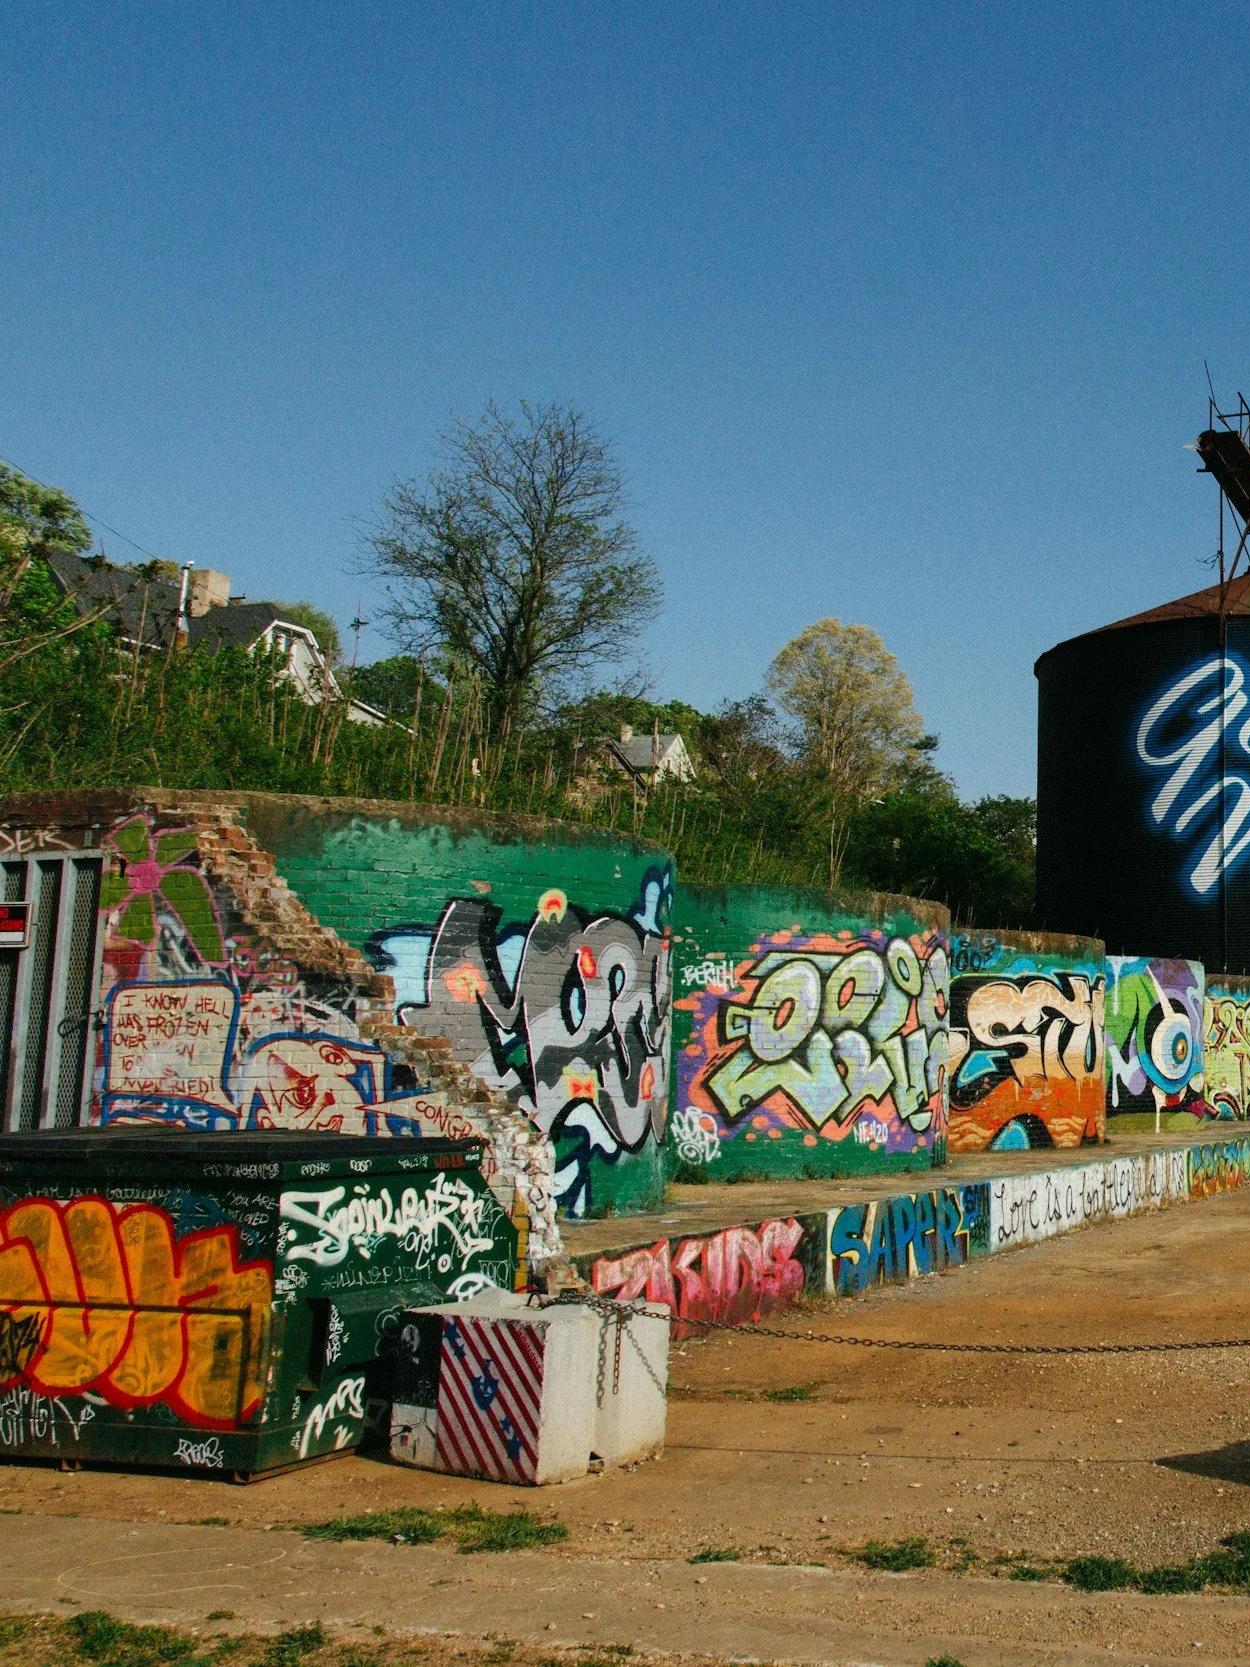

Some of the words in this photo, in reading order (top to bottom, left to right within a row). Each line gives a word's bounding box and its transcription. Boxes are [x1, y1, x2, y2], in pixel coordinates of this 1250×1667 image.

[121, 995, 136, 1007] I
[144, 993, 188, 1011] KNOW
[195, 997, 230, 1019] HELL
[117, 1013, 144, 1031] HAS
[146, 1013, 209, 1039] FROZEN
[113, 1033, 148, 1050] OVER
[995, 1183, 1040, 1242] Love
